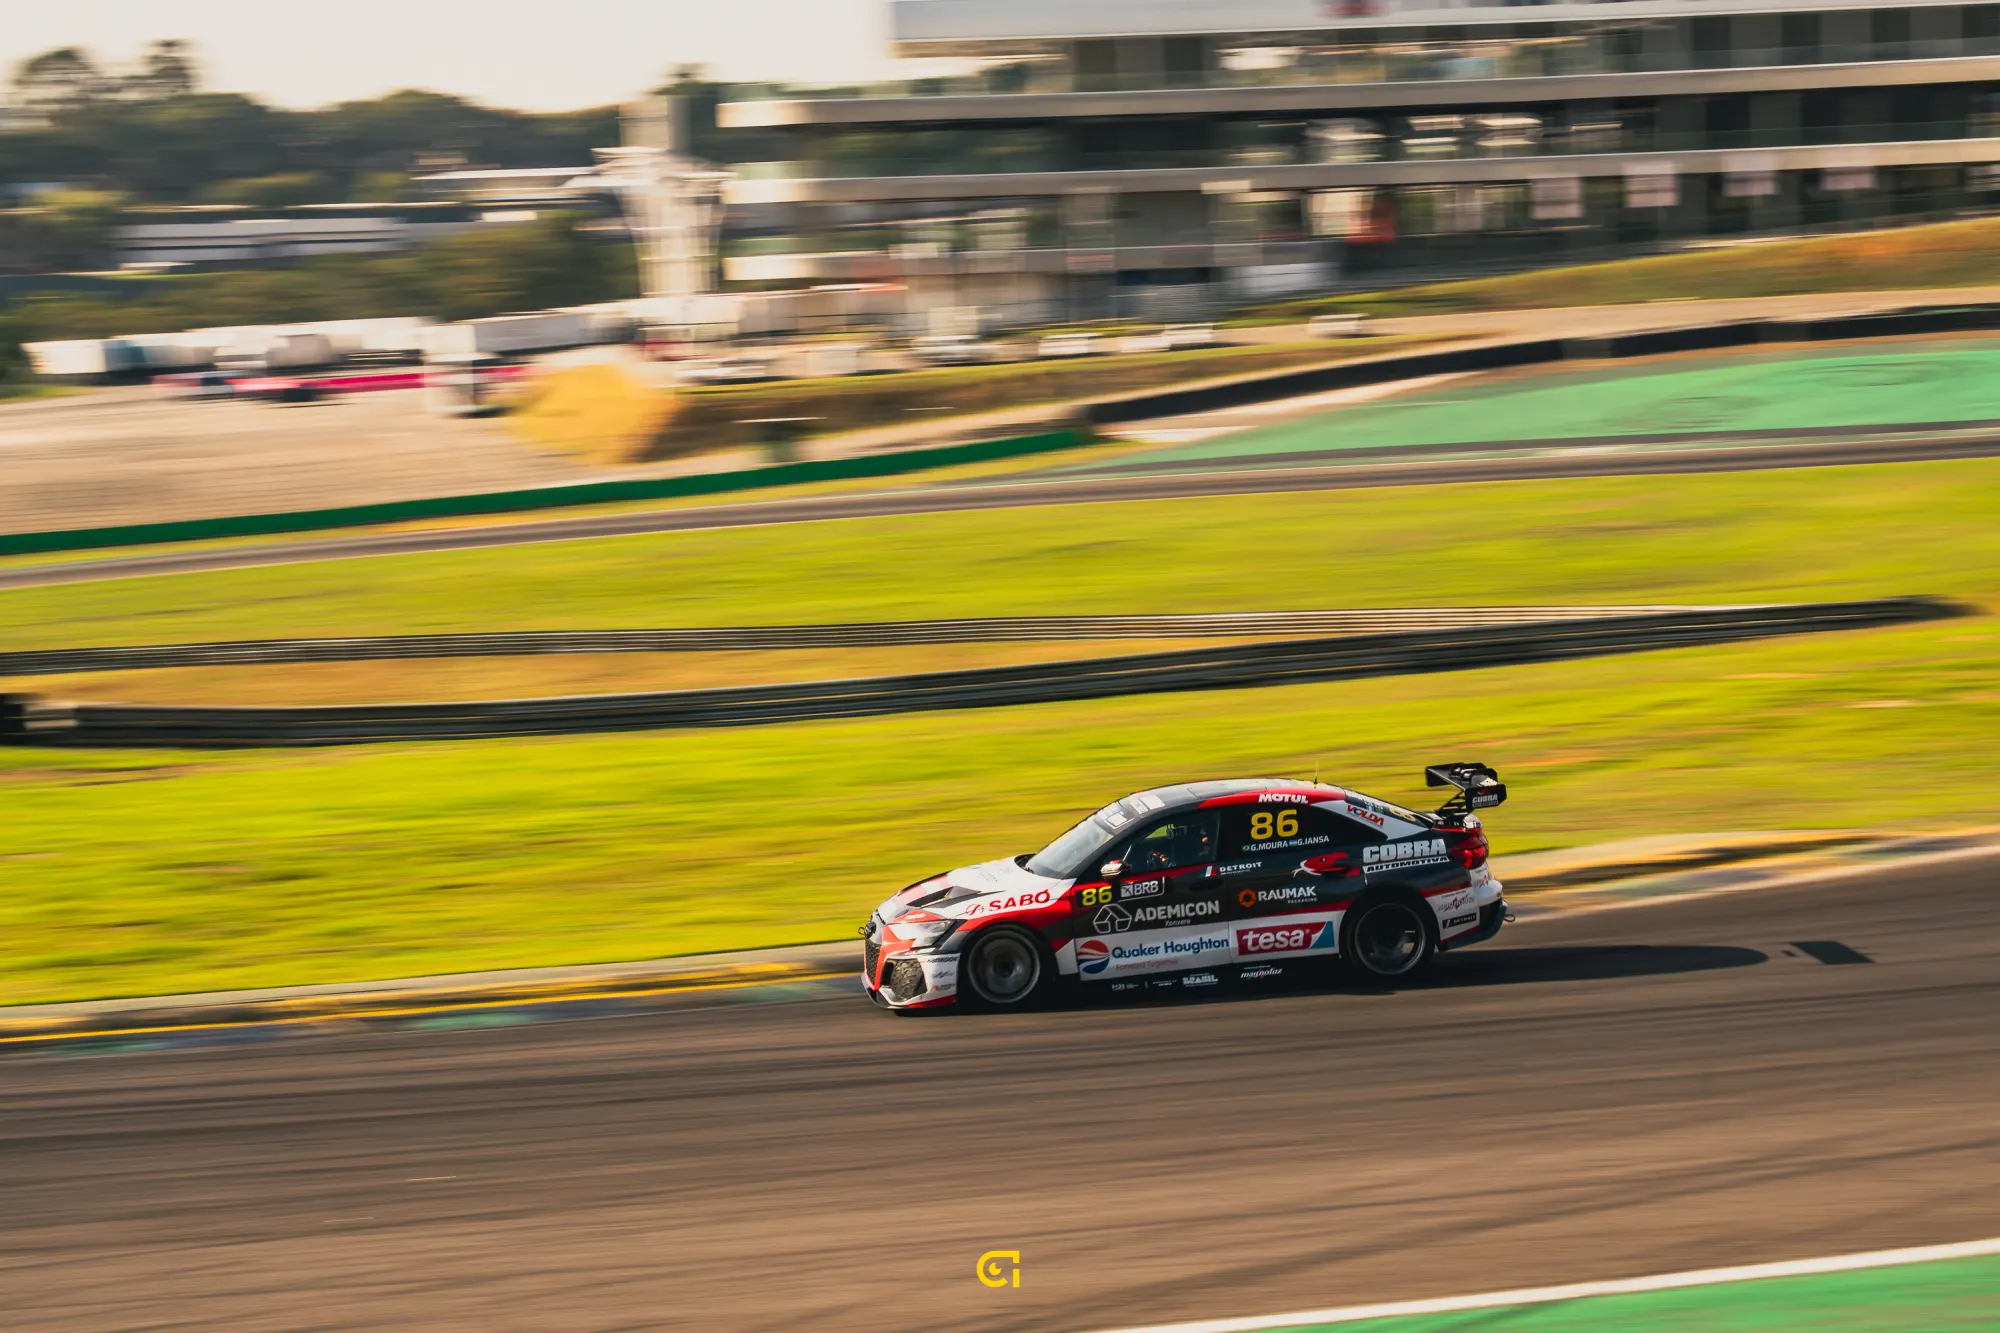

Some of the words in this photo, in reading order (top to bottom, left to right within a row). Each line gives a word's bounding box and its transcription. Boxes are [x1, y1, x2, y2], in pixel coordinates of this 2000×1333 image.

[1258, 793, 1308, 804] MOTUL
[1250, 809, 1299, 840] 86
[1250, 840, 1288, 852] G.MOURA
[1363, 838, 1447, 864] COBRA
[1220, 861, 1263, 872] DETROIT
[1366, 856, 1449, 873] AUTOMOTIVA
[1082, 885, 1113, 906] 86
[1133, 880, 1159, 896] BRB
[1258, 886, 1316, 901] RAUMAK
[1134, 900, 1220, 922] ADEMICON
[1111, 940, 1161, 959] Quaker
[1164, 937, 1229, 954] Houghton
